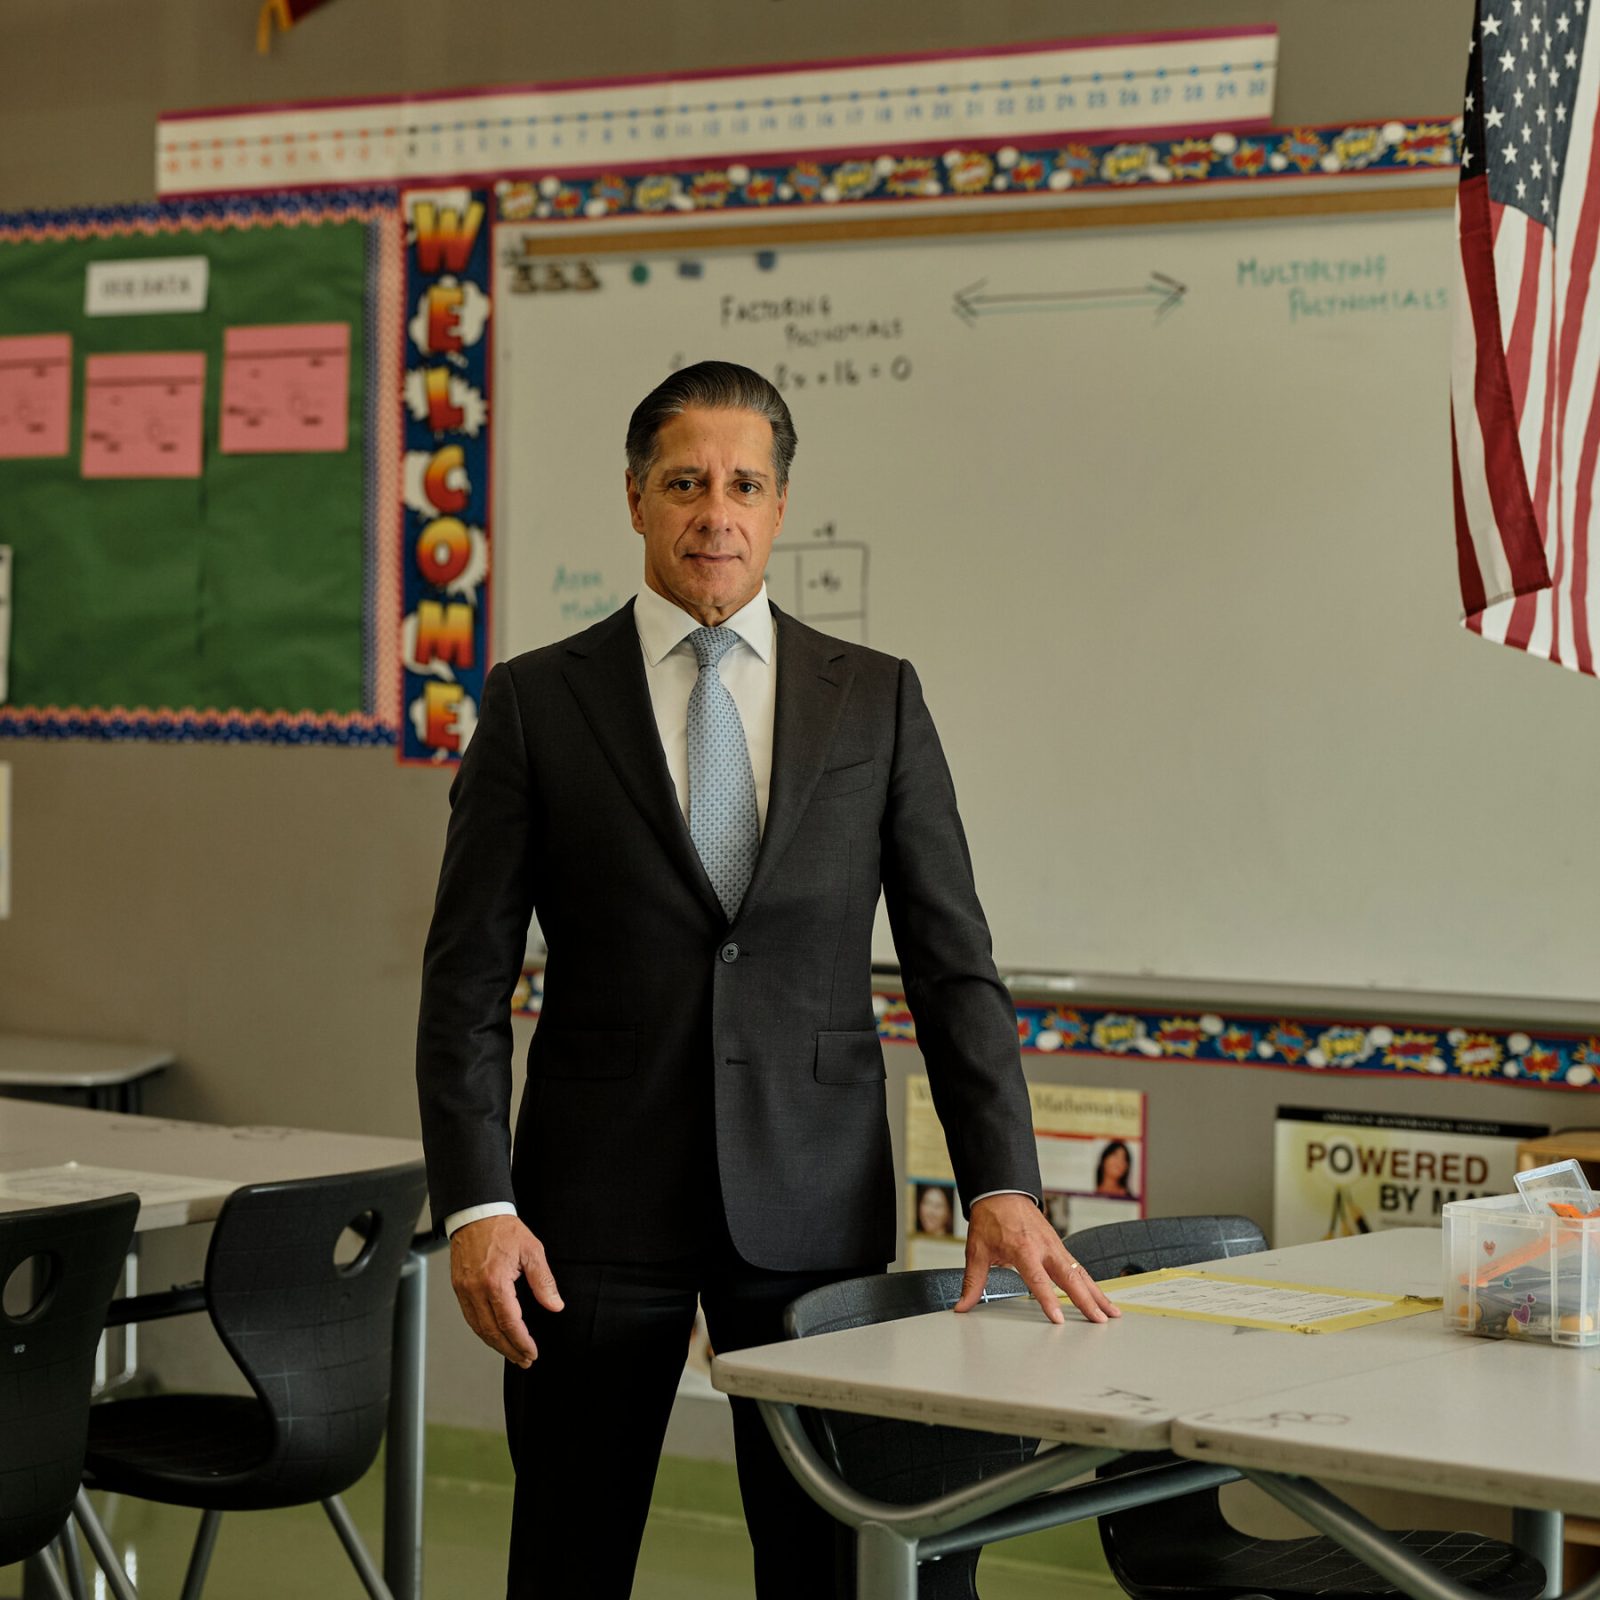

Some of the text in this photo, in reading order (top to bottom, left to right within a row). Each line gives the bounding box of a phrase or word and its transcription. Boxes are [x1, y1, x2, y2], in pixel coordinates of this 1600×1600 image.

[413, 202, 485, 750] WELCOME
[1306, 1142, 1490, 1186] POWERED
[1379, 1184, 1421, 1214] BY
